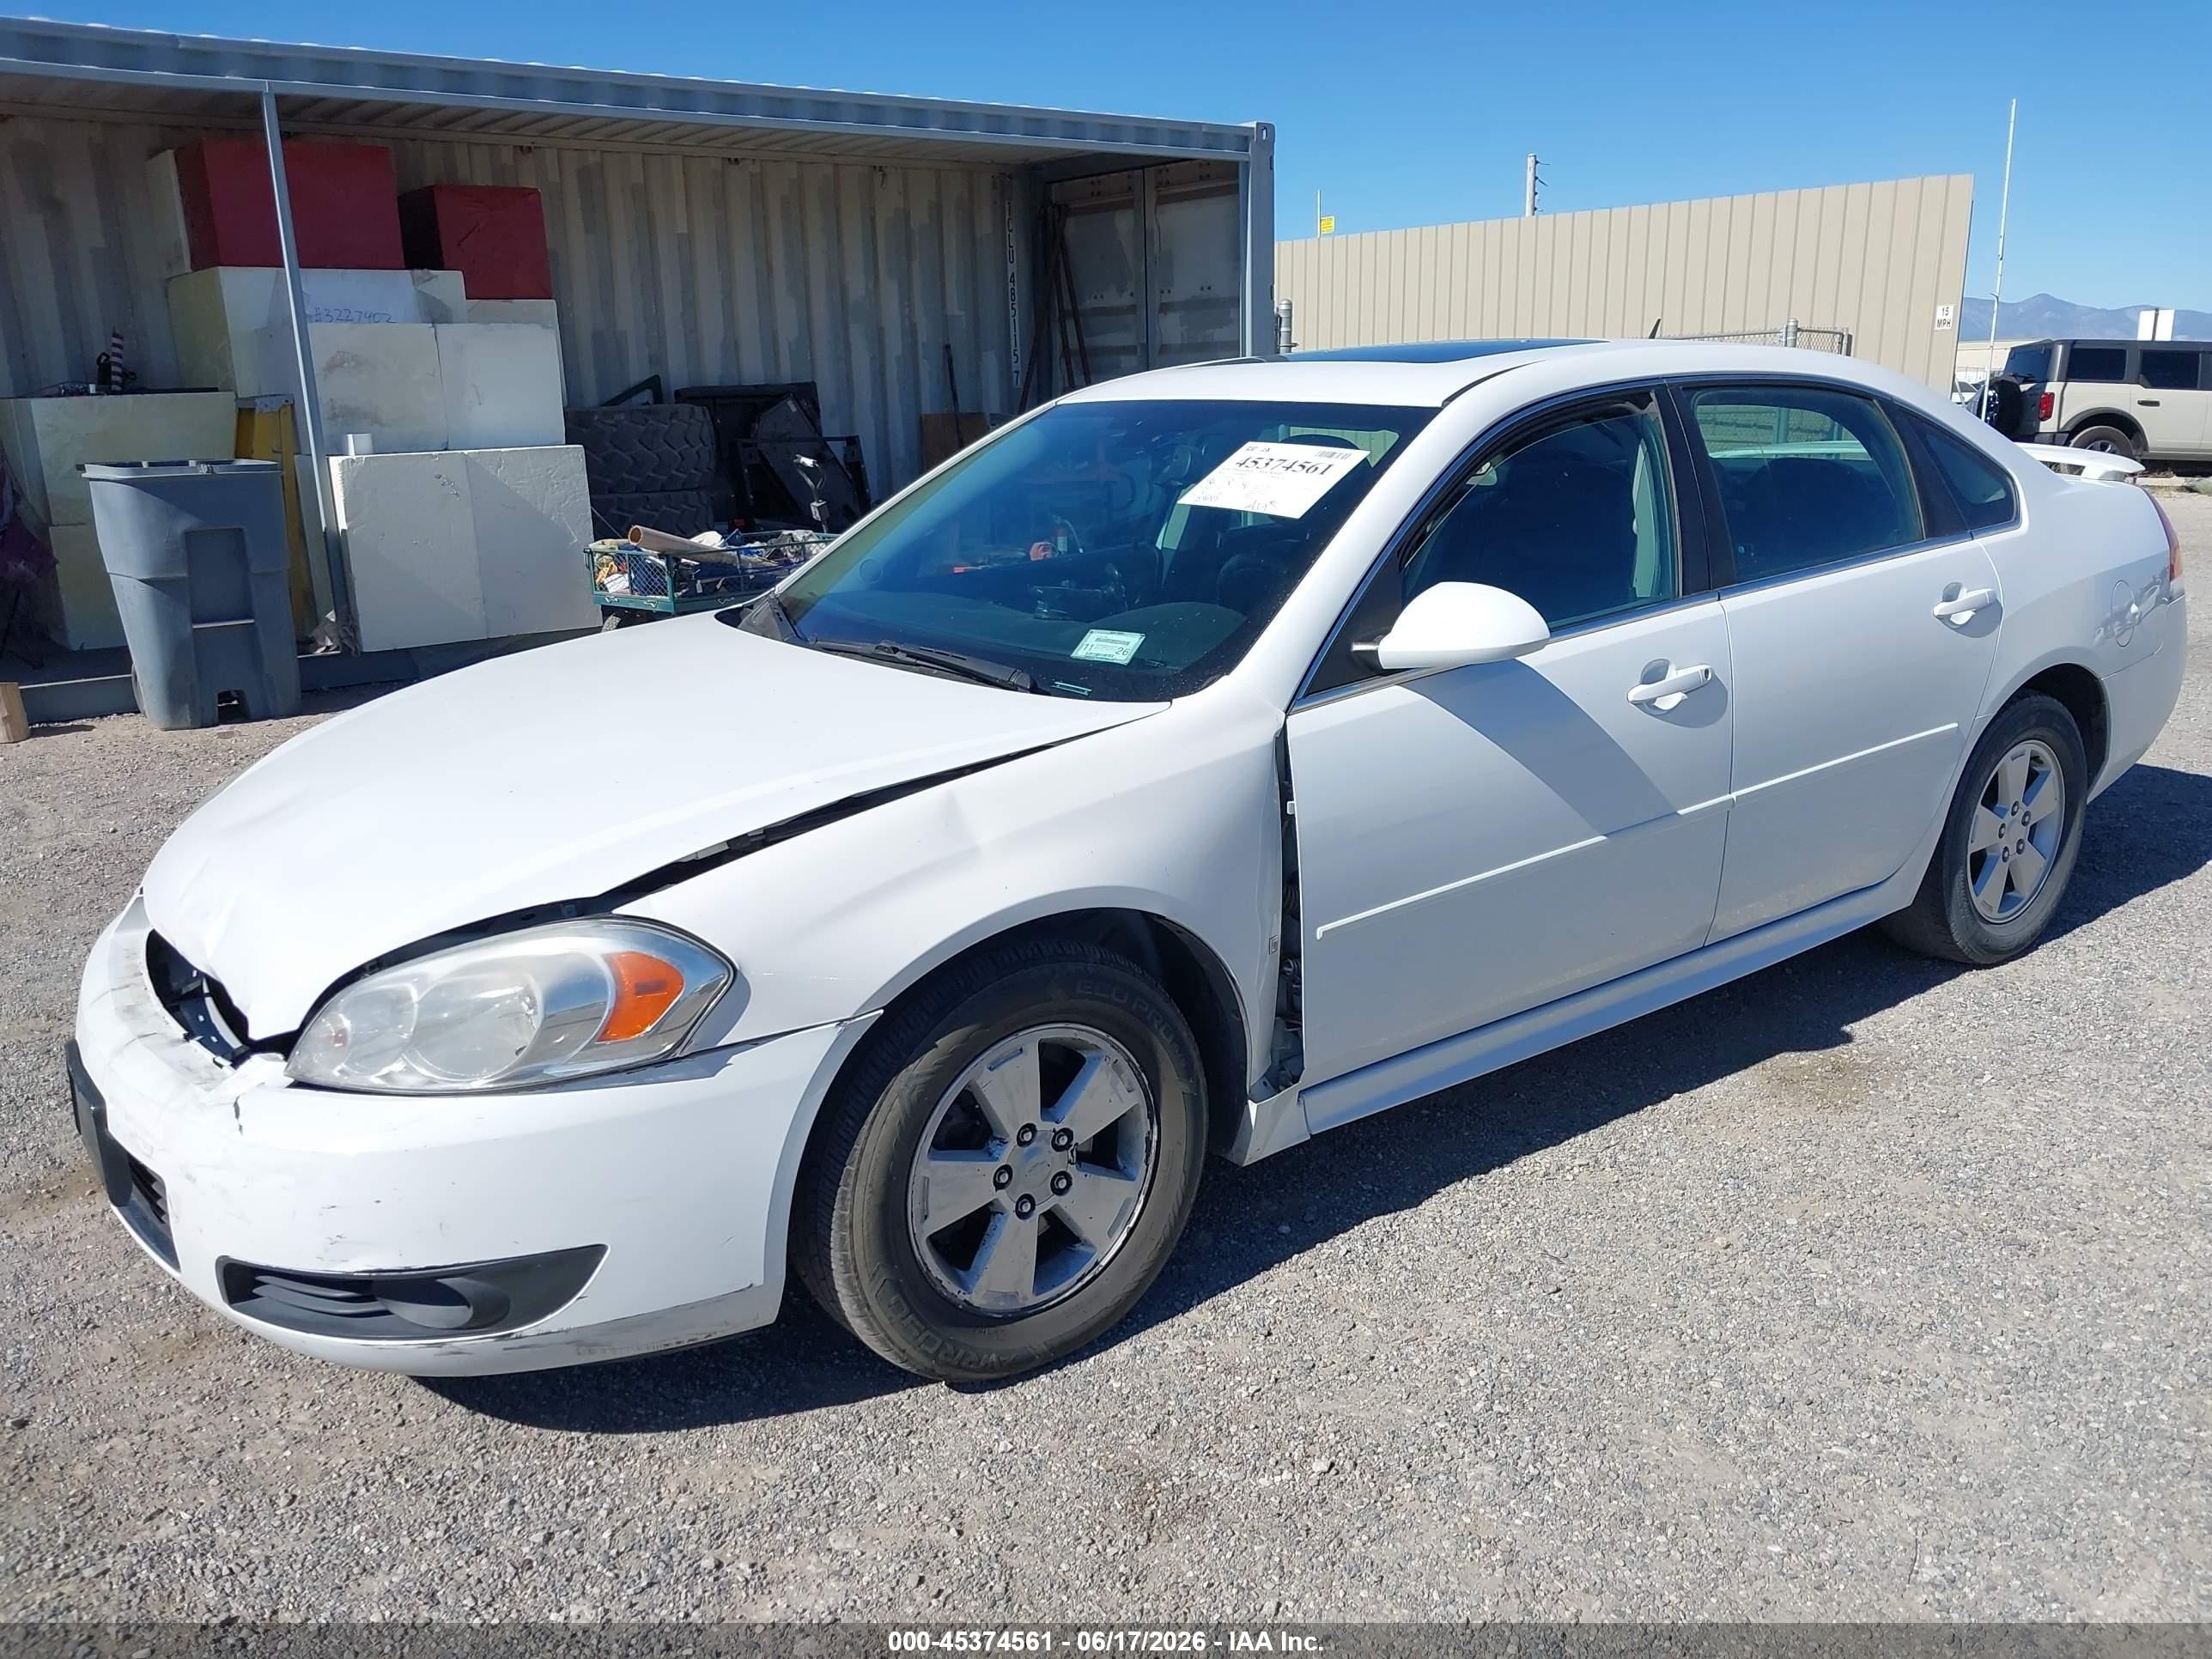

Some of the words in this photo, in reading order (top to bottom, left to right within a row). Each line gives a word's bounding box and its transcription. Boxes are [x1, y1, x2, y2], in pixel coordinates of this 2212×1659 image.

[1009, 271, 1019, 364] 485115
[1942, 307, 1950, 316] 15
[1937, 319, 1951, 328] MPH
[1013, 371, 1020, 386] 7
[1236, 456, 1334, 476] 45374561
[1115, 647, 1131, 656] 26
